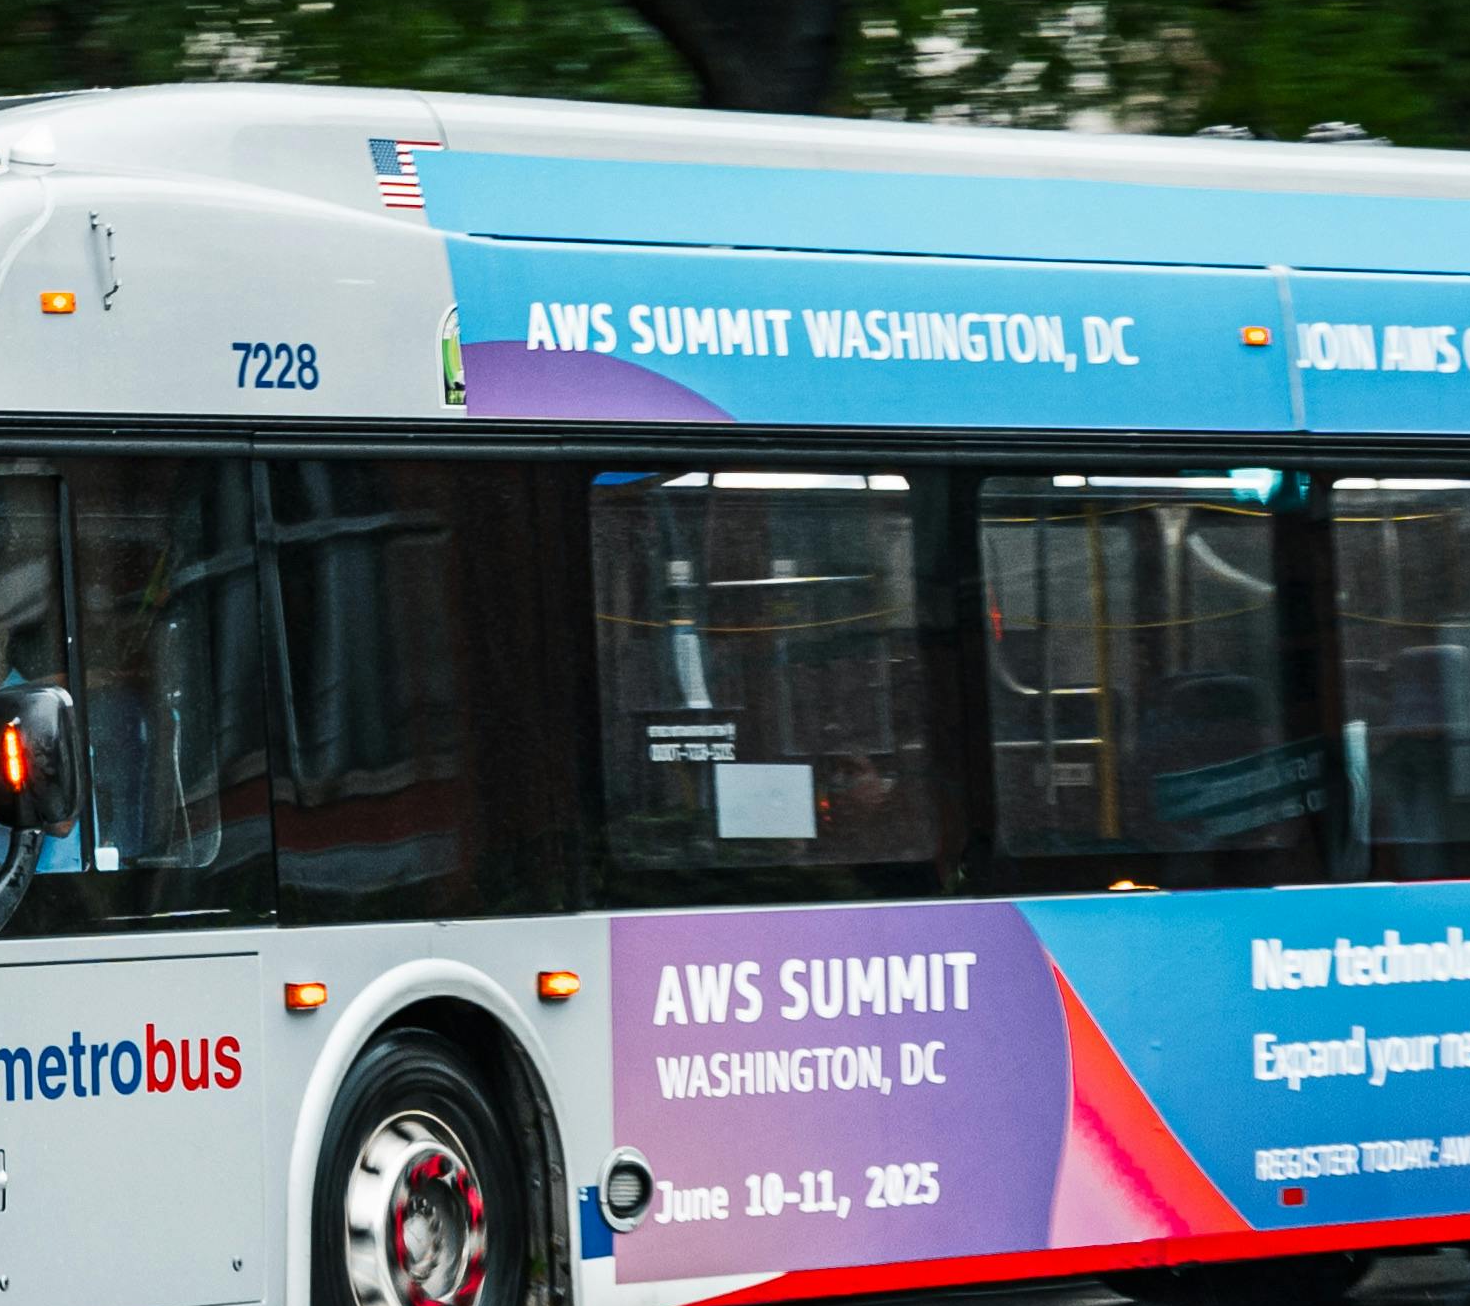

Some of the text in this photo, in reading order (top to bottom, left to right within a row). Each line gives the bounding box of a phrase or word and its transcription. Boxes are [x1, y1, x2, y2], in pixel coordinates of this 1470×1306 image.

[232, 342, 319, 390] 7228
[527, 302, 1140, 373] AWS SUMMIT WASHINGTON, DC
[1296, 322, 1376, 370] JOIN
[1382, 326, 1460, 372] AWS
[653, 952, 977, 1026] AWS SUMMIT
[1252, 939, 1331, 990] New
[656, 1041, 946, 1099] WASHINGTON, DC
[1253, 1025, 1366, 1091] Expand
[1367, 1035, 1439, 1086] your
[1255, 1144, 1360, 1181] REGISTER
[654, 1162, 940, 1223] June 10-11, 2025
